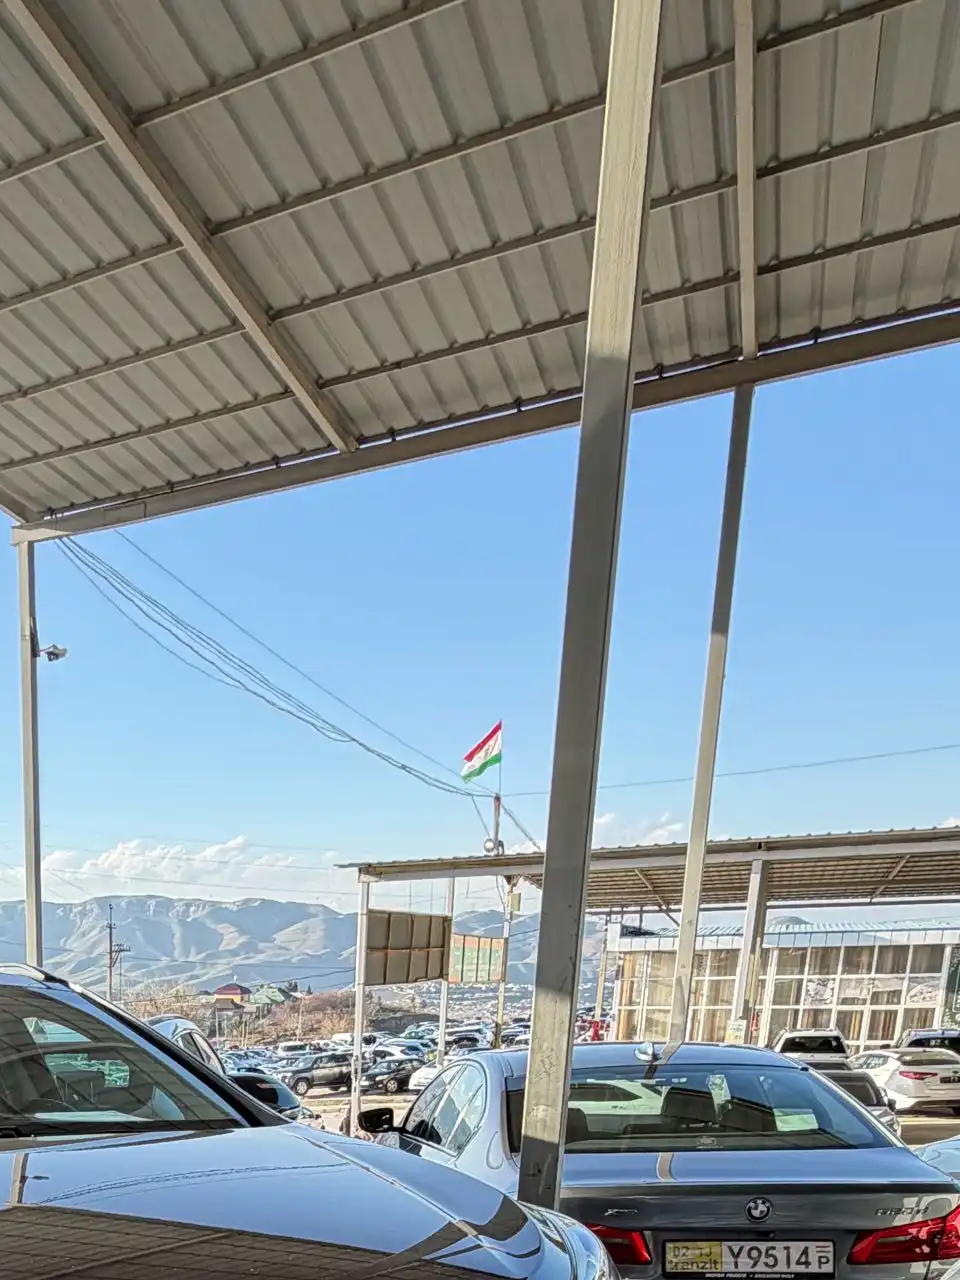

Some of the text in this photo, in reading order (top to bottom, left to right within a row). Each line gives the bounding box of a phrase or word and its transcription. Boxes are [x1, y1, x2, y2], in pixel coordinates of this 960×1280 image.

[672, 1246, 690, 1258] 02
[727, 1245, 812, 1269] Y9514
[817, 1256, 831, 1269] P
